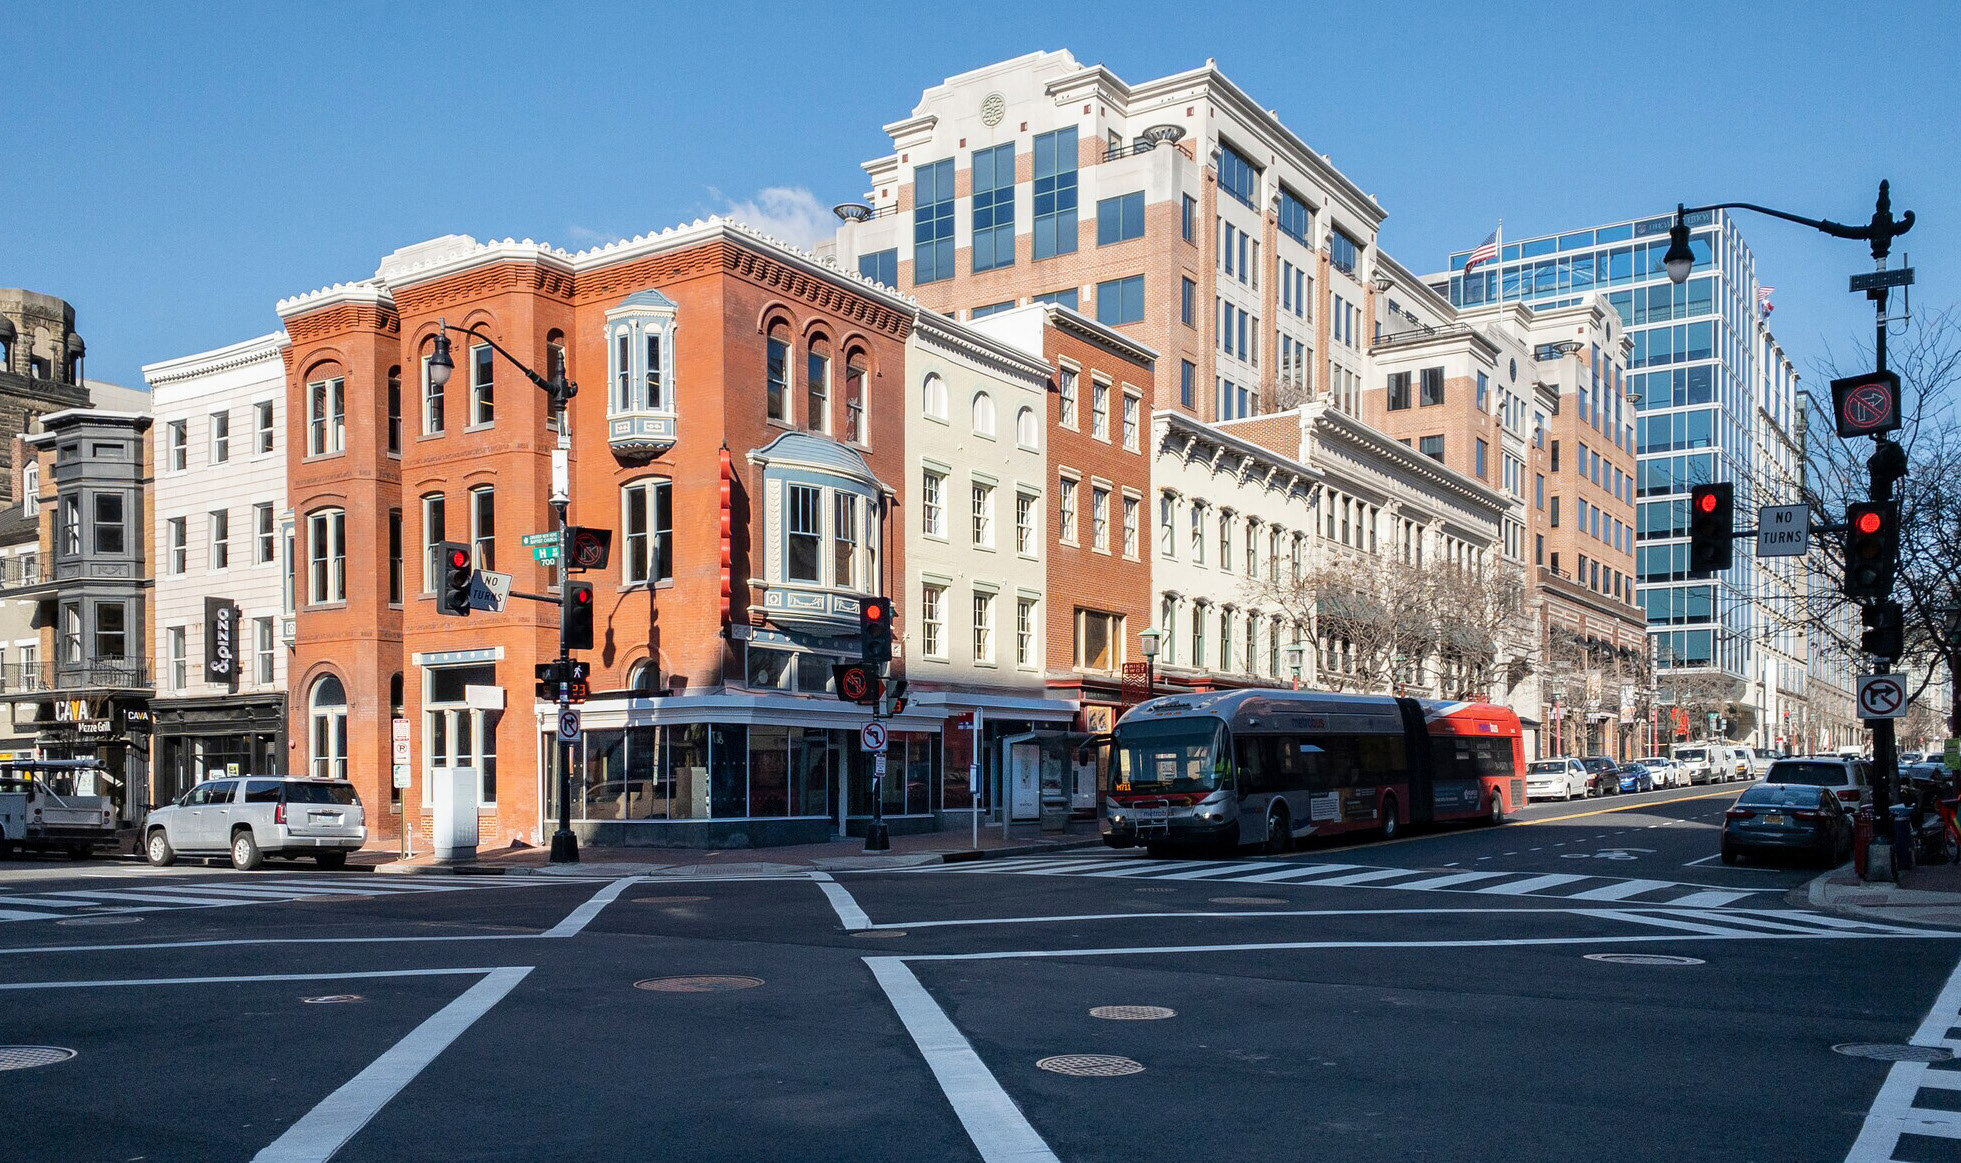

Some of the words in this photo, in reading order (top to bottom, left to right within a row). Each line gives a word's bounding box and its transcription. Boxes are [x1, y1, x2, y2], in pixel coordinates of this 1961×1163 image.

[1775, 511, 1793, 523] NO
[1763, 530, 1802, 544] TURNS
[538, 548, 547, 558] H
[540, 558, 555, 566] 700
[484, 576, 498, 586] NO
[473, 590, 503, 602] TURNS
[210, 608, 232, 673] &pizza
[572, 684, 586, 696] 23
[55, 699, 90, 721] CAVA
[127, 711, 149, 720] CAVA
[97, 721, 111, 732] Grill
